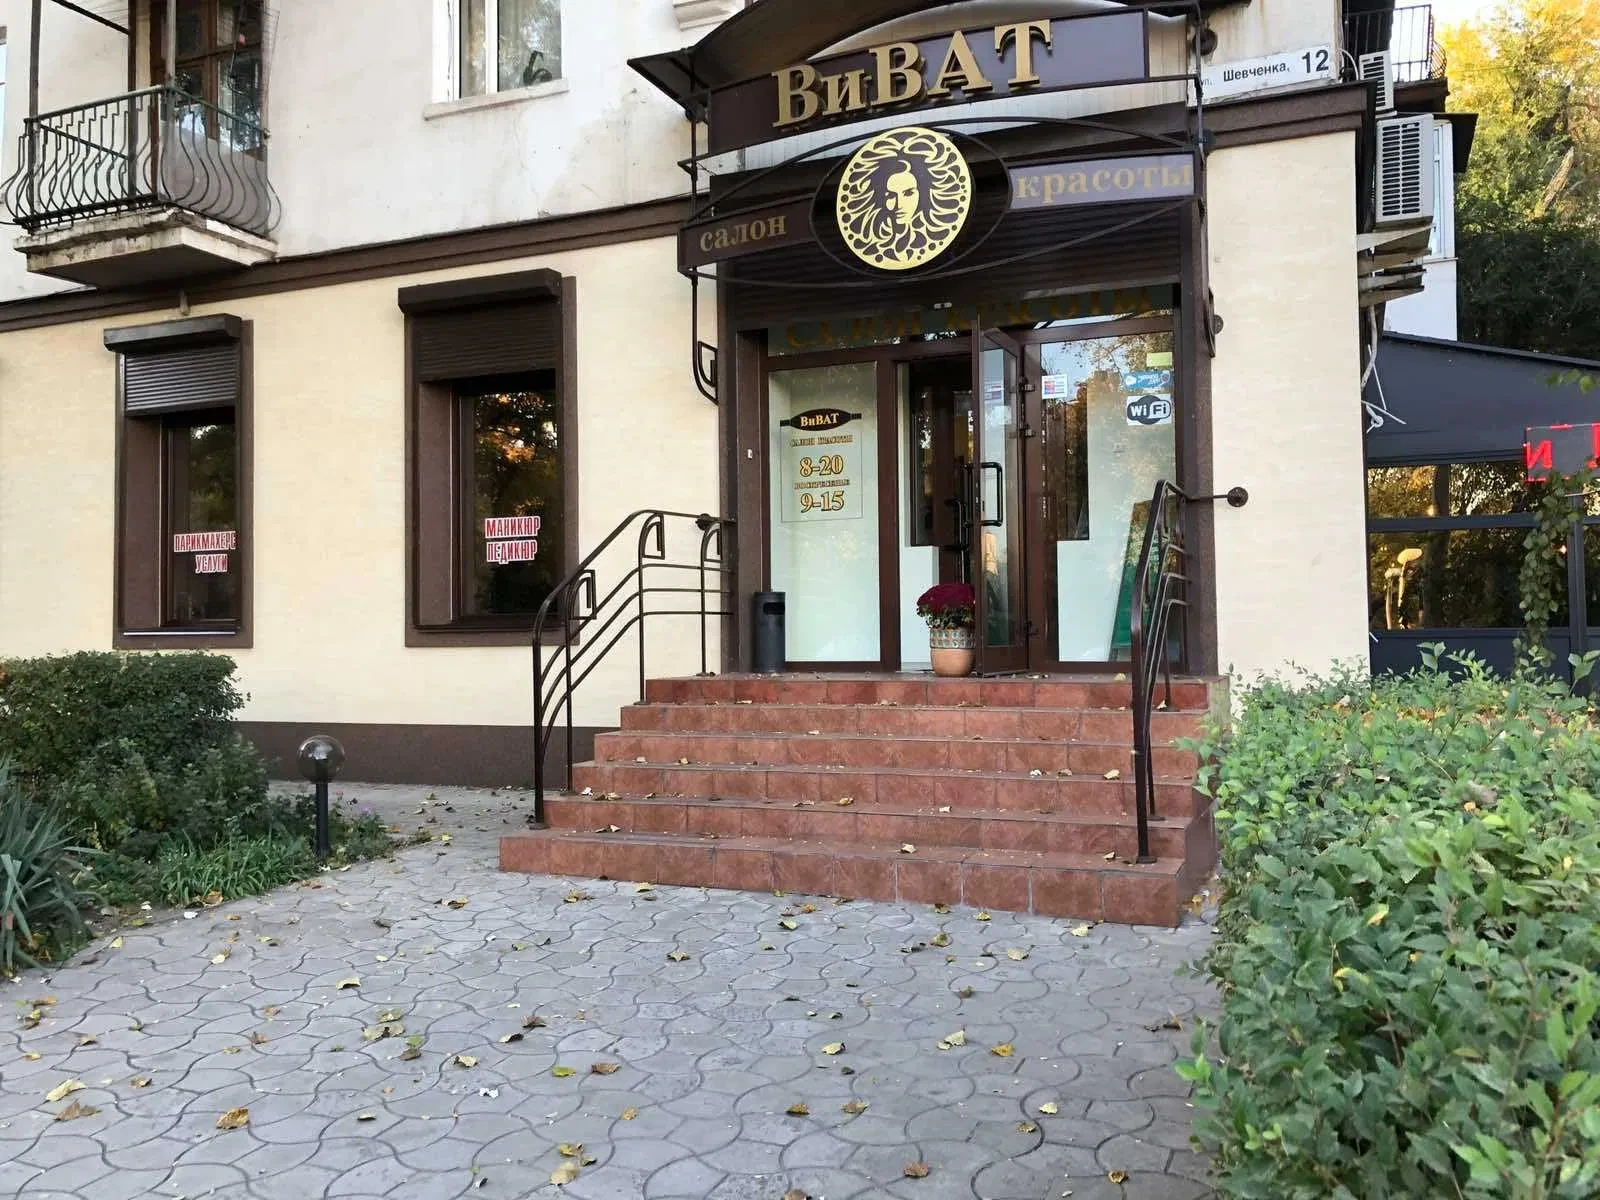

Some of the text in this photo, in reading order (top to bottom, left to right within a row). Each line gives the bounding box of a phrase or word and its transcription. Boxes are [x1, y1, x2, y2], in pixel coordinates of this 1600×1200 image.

[771, 19, 1052, 128] ВиВАТ
[1223, 61, 1290, 82] Шевченка,
[1302, 49, 1330, 74] 12
[700, 164, 1192, 252] салон красоты
[800, 413, 839, 427] ВиВАТ
[800, 455, 844, 477] 8-20
[800, 490, 845, 513] 9-15
[485, 516, 540, 538] МАНИКЮР
[195, 554, 227, 573] УСЛУГИ
[487, 540, 537, 564] ПЕДИКЮР
